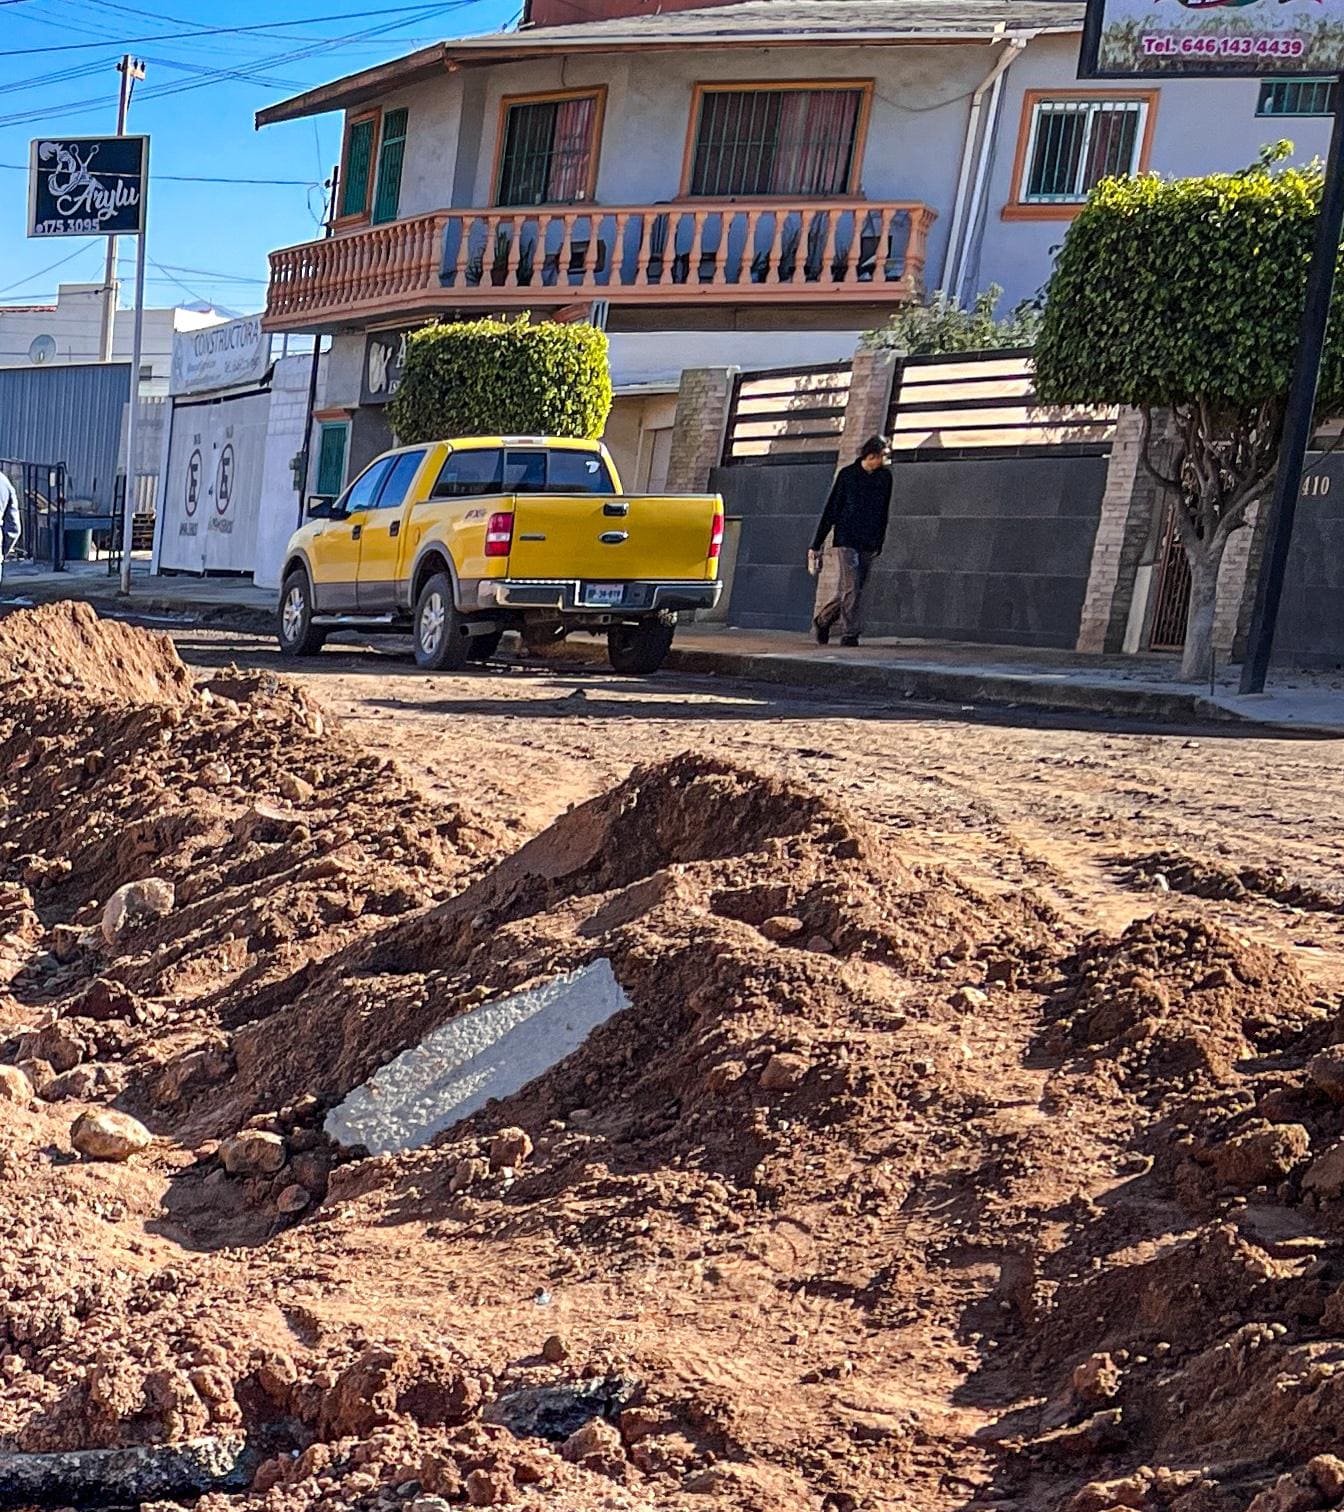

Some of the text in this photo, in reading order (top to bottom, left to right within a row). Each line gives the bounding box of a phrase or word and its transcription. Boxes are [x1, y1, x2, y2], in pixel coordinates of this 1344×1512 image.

[1143, 37, 1304, 56] Tel. 646 143 4439
[56, 178, 141, 221] Arylu
[42, 218, 101, 234] 175 3095
[194, 321, 259, 358] CONSTRUCTORA
[1302, 475, 1330, 496] 410
